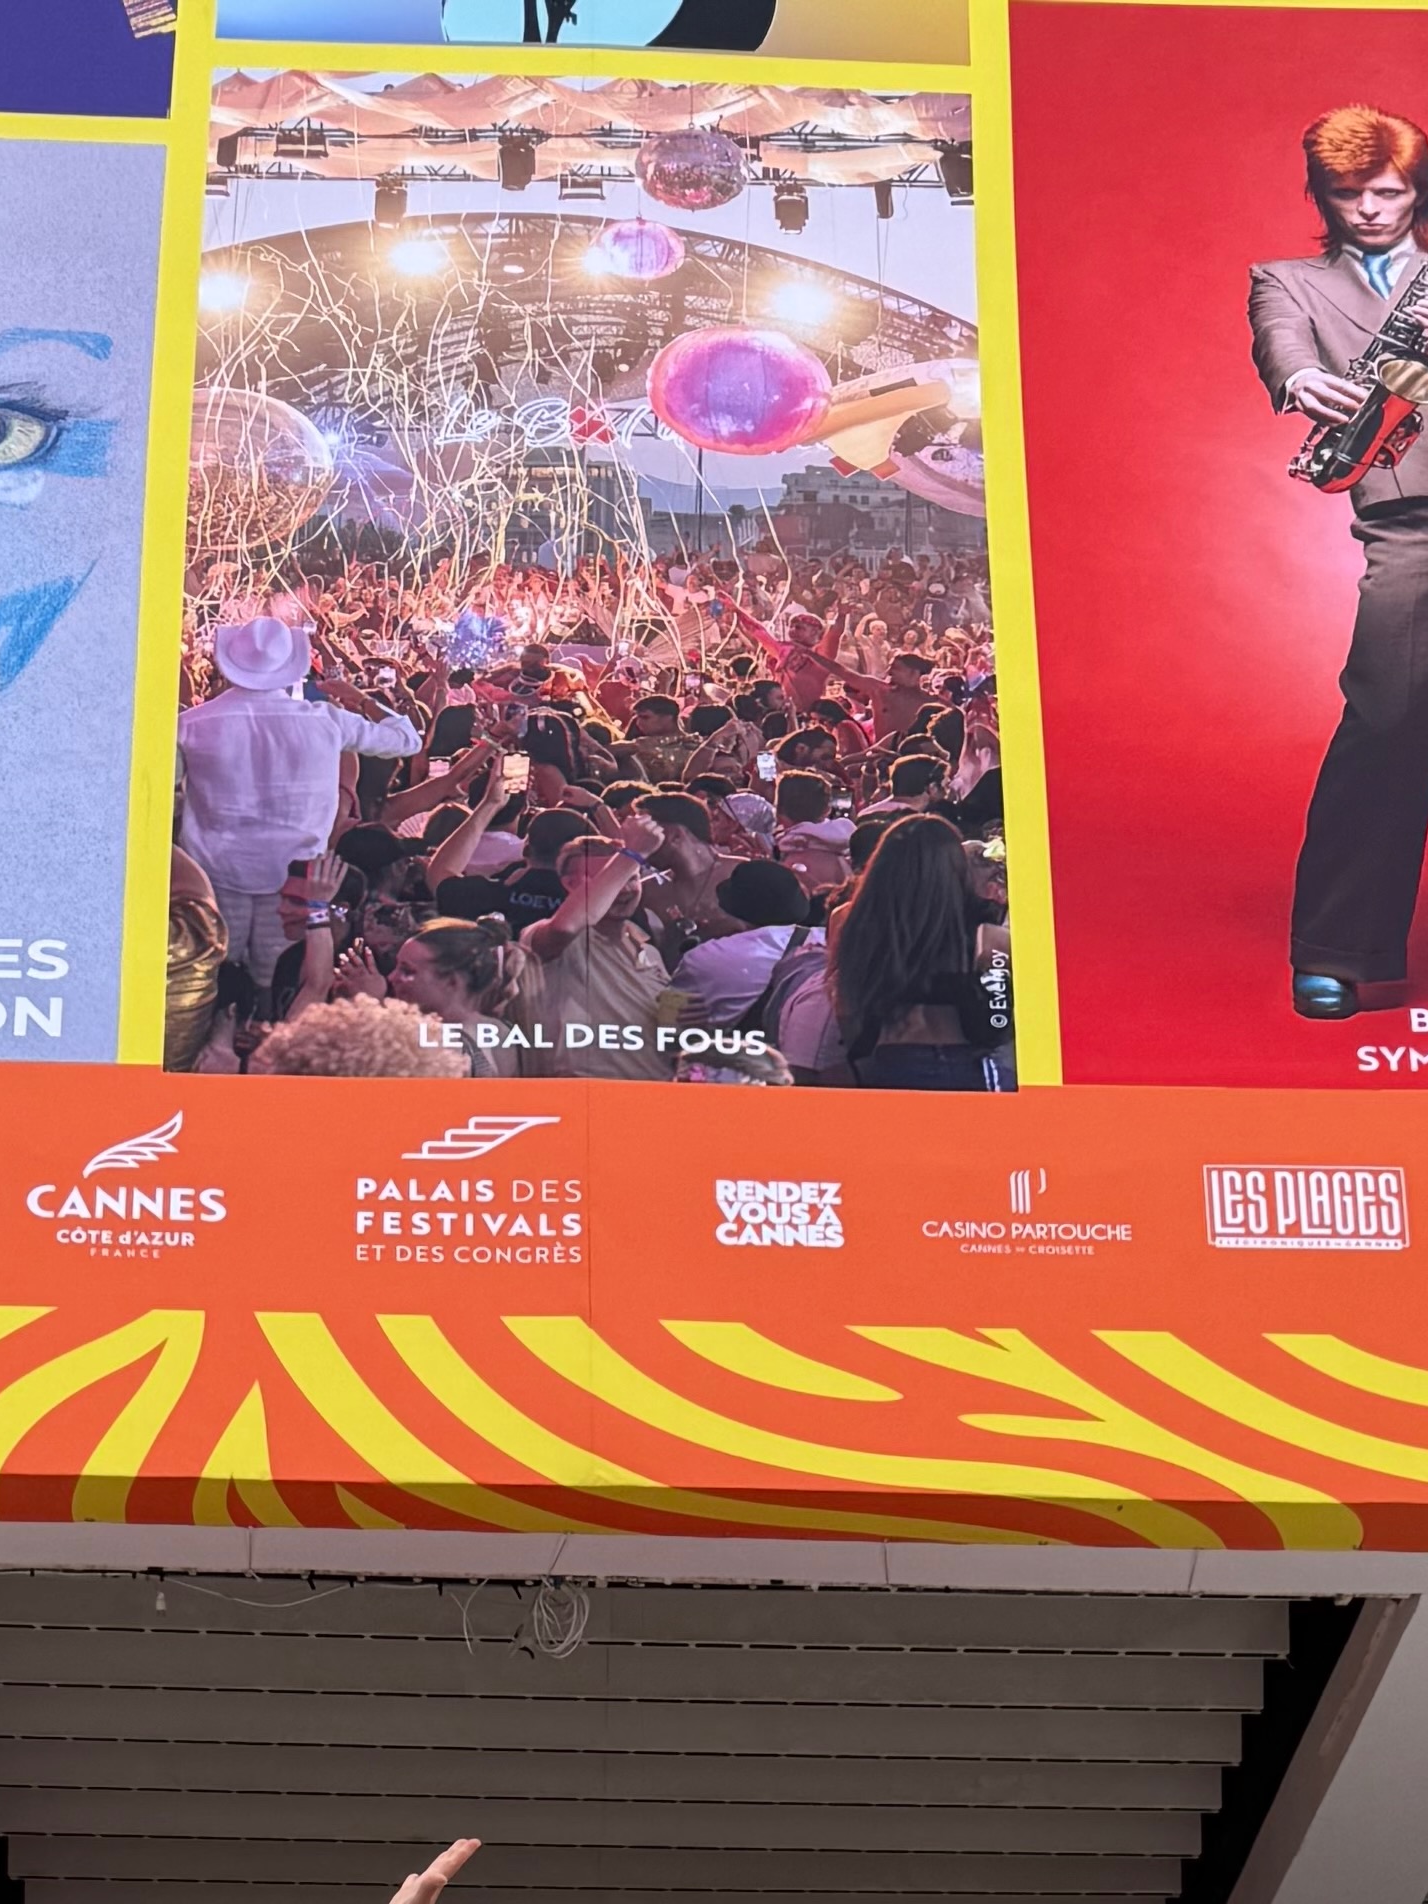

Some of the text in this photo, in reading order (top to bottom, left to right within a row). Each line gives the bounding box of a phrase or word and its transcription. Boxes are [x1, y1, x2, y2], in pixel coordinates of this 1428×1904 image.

[514, 398, 650, 449] Bl
[509, 891, 560, 910] LOEW
[418, 1023, 766, 1056] LE BAL DES FOUS
[356, 1177, 582, 1203] PALAIS DES
[715, 1179, 842, 1205] RENDEZ
[1210, 1169, 1402, 1236] LES PLAGES
[26, 1184, 227, 1222] CANNES
[716, 1200, 811, 1225] VOUS
[56, 1226, 195, 1247] CÔTE d'AZUR
[356, 1211, 582, 1237] FESTIVALS
[715, 1223, 845, 1248] CANNES
[922, 1220, 1132, 1241] CASINO PARTOUCHE
[89, 1248, 161, 1259] FRANCE
[356, 1241, 582, 1263] ET DES CONGRÈS
[959, 1243, 1012, 1254] CANNES
[1028, 1244, 1095, 1256] CROISETTE
